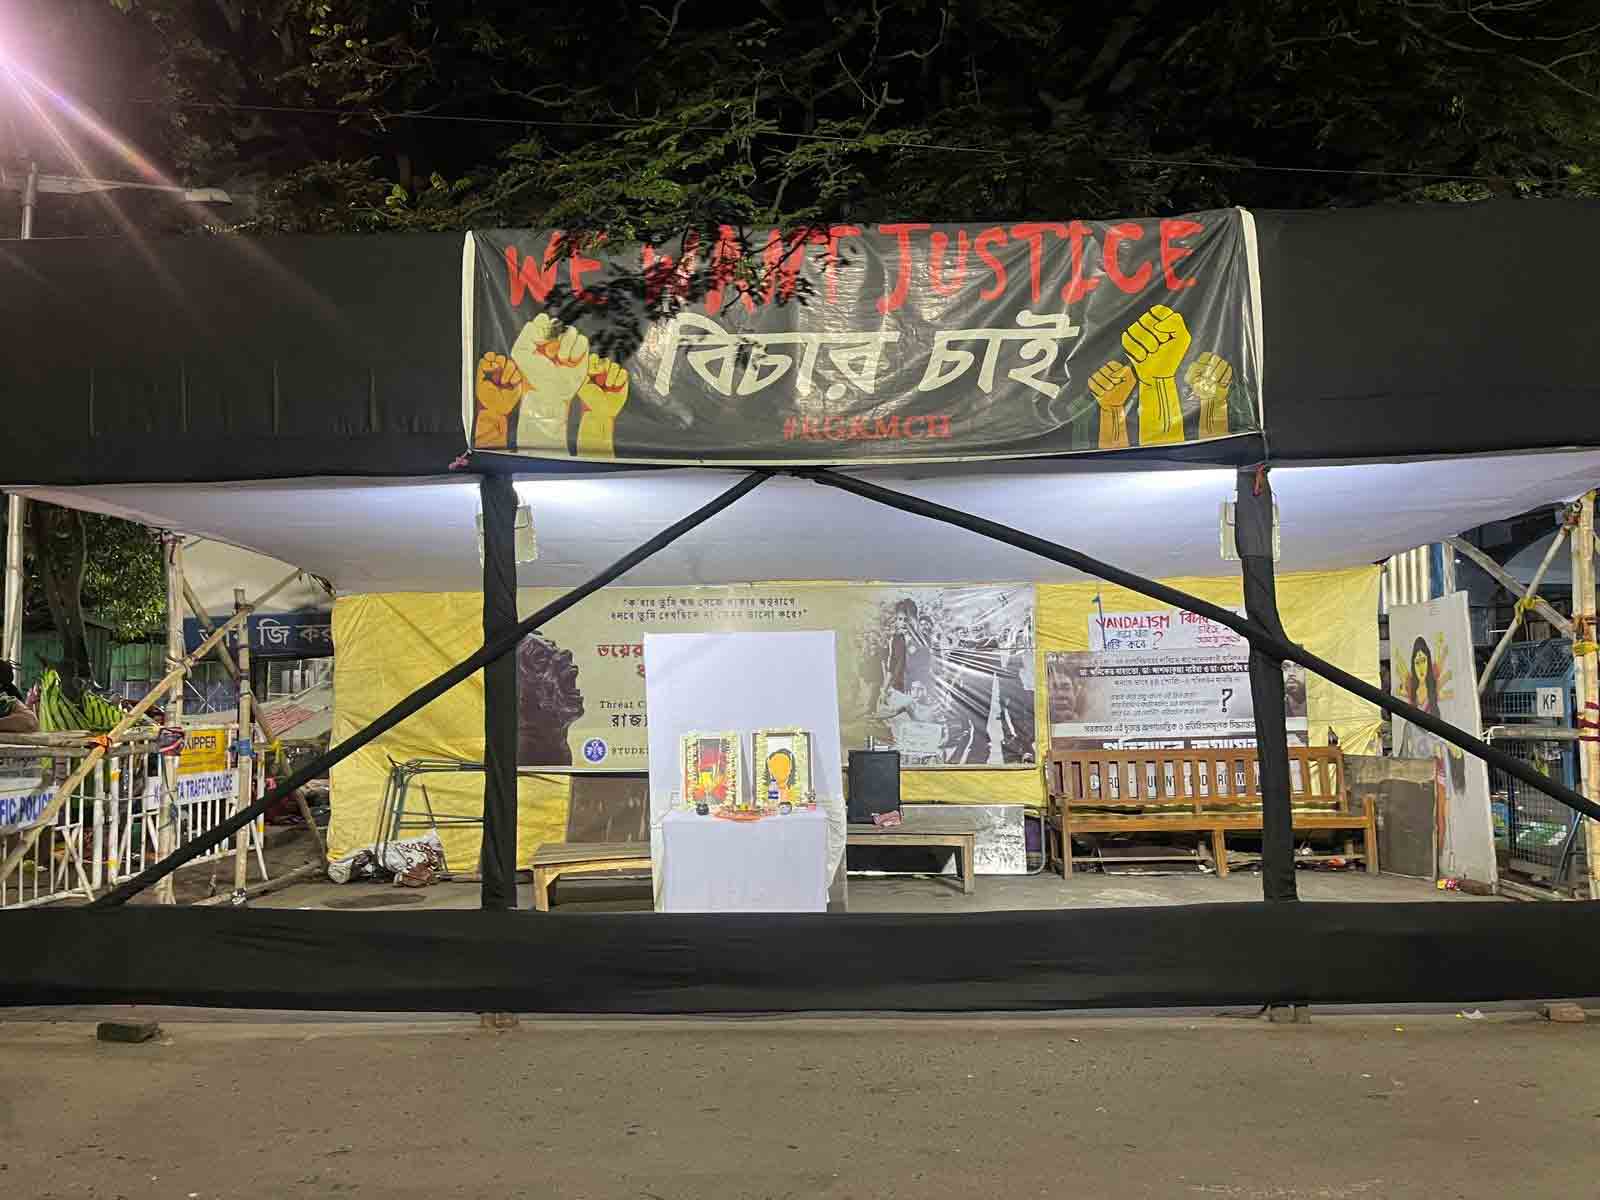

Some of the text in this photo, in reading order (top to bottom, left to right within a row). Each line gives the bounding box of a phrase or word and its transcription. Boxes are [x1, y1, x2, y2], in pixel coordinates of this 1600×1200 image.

[504, 228, 608, 306] WE
[876, 219, 1205, 315] JUSTICE
[654, 309, 1080, 399] বিচার চাই
[255, 618, 291, 647] জি
[1543, 694, 1557, 710] KP
